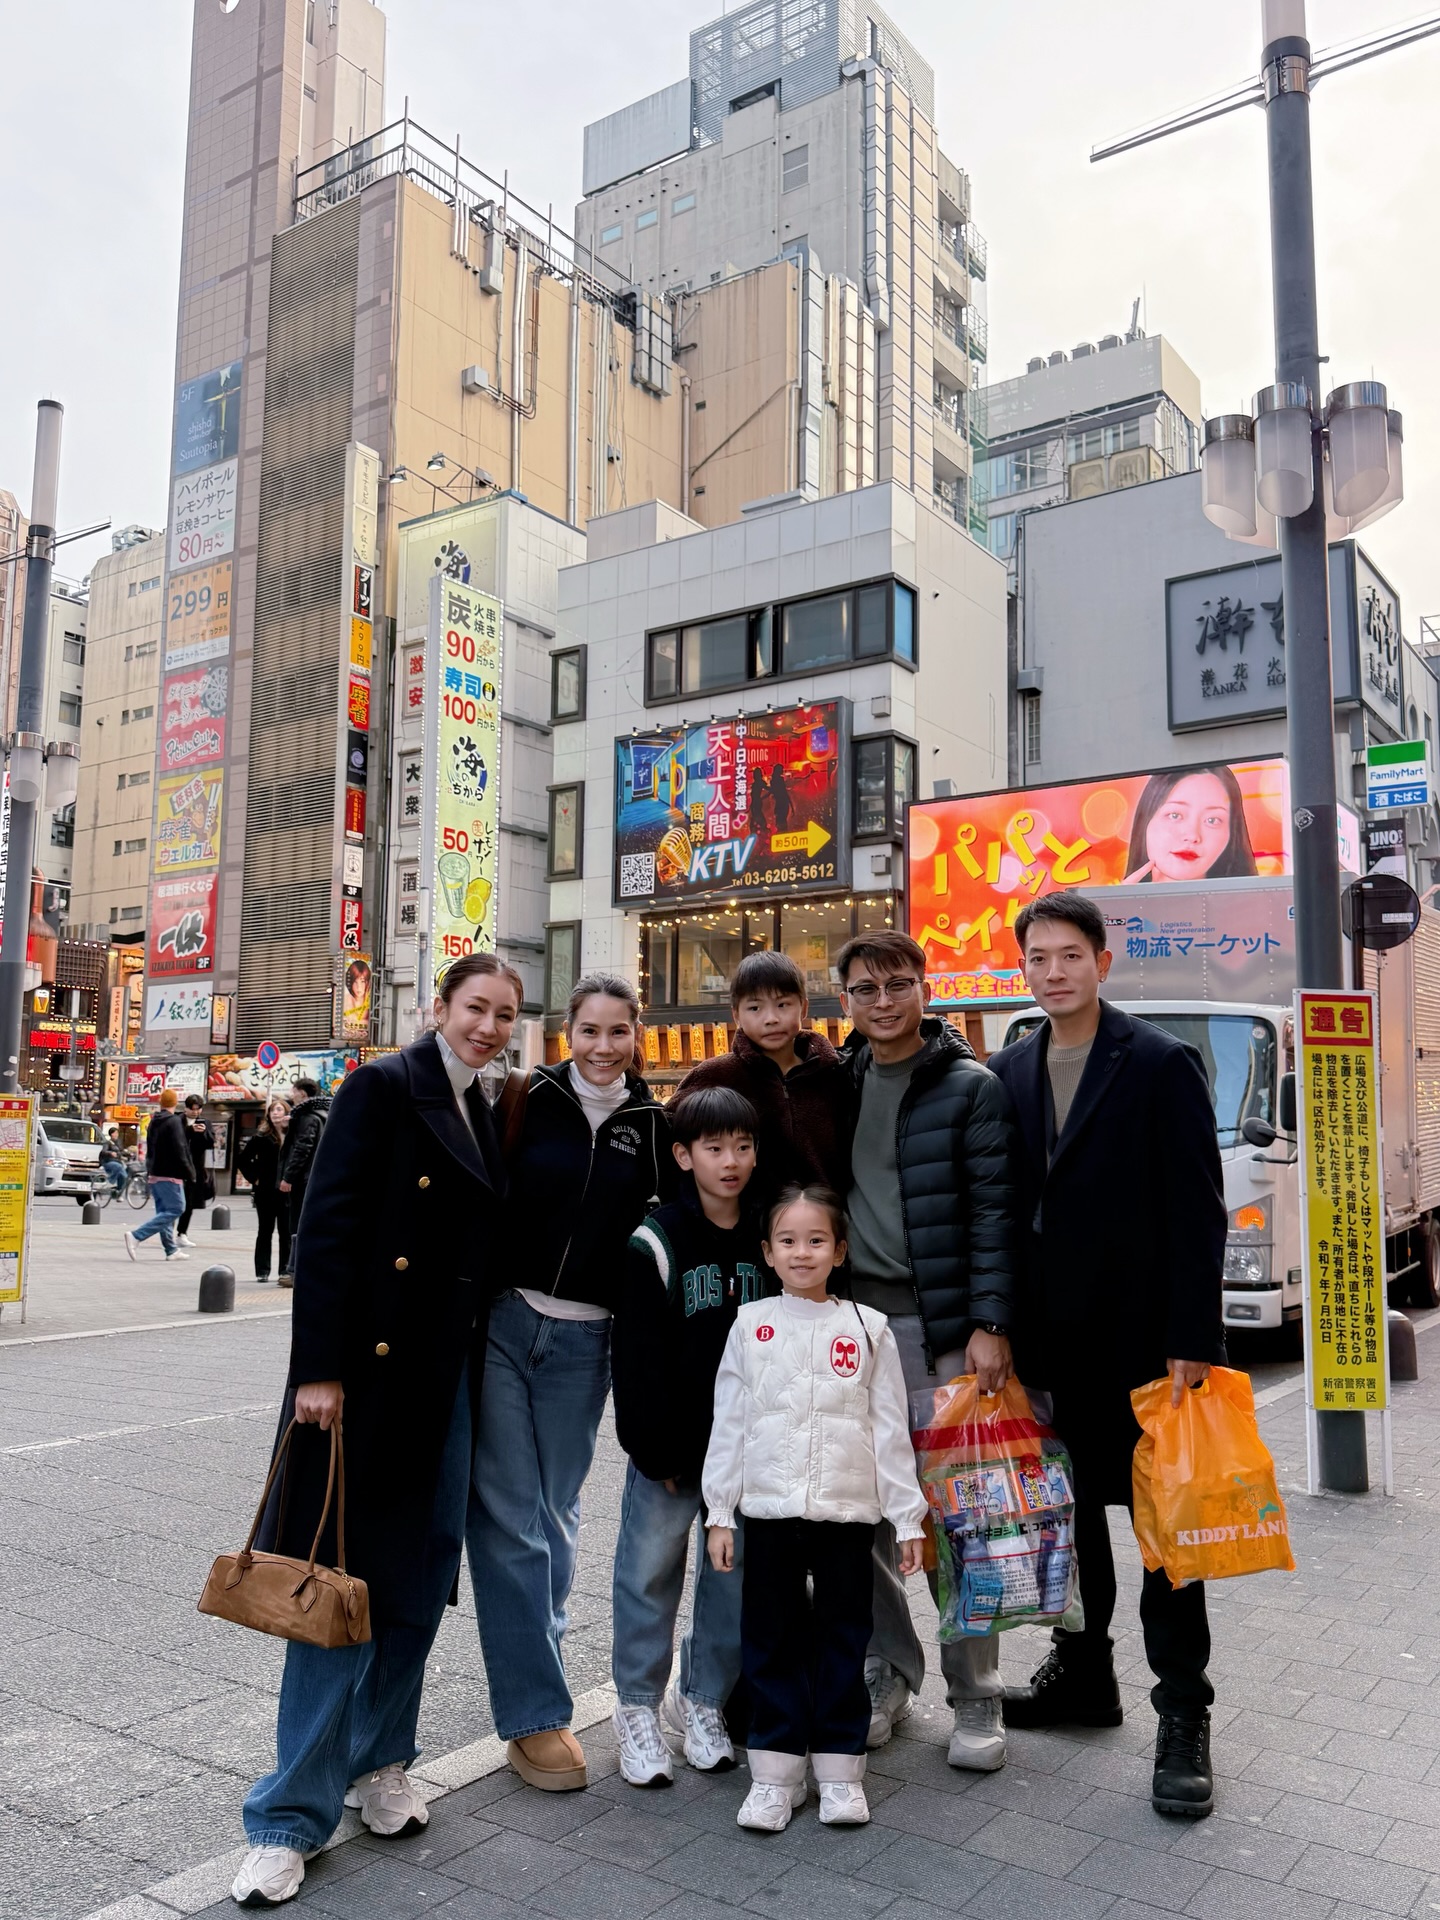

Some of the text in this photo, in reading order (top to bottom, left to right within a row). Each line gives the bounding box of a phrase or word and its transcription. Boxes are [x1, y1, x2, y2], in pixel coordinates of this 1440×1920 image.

[181, 386, 195, 402] 5F
[188, 418, 212, 434] shisha
[179, 439, 218, 462] Suutopia
[177, 467, 235, 499] ハイボール
[177, 489, 234, 517] レモンサワー
[175, 508, 233, 536] 豆挽きコーヒー
[360, 570, 371, 607] ダーツ
[446, 630, 495, 670] 90 円から
[444, 666, 482, 700] 寿司
[1202, 681, 1248, 698] KANKA
[350, 685, 369, 725] 麻雀
[443, 694, 496, 731] 100 円から
[166, 711, 209, 730] ダーツバー
[708, 725, 732, 841] 天上人間
[1370, 766, 1425, 781] FamilyMart
[175, 778, 204, 809] 低料金
[405, 763, 421, 816] 大衆
[452, 782, 484, 801] ちから
[1374, 791, 1423, 806] 酒 たばこ
[158, 818, 192, 841] 麻雀
[443, 827, 469, 853] 50
[484, 821, 494, 858] レモン
[472, 838, 485, 876] サワー
[689, 836, 754, 881] KTV
[934, 811, 1092, 895] パパッと
[745, 863, 834, 885] 03-6205-5612
[347, 886, 358, 896] 3F
[401, 872, 418, 925] 酒場
[159, 910, 207, 957] 一休
[1160, 925, 1216, 935] New generation
[442, 934, 473, 957] 150
[1127, 932, 1281, 959] 物流マーケット
[197, 957, 211, 969] 2F
[928, 973, 1034, 999] 心安全に出
[1310, 1006, 1364, 1034] 通告
[143, 1076, 163, 1095] 一休
[611, 1125, 641, 1144] HOLLYWOOD
[1311, 1053, 1327, 1196] 場合には、区が処分します。
[610, 1138, 618, 1148] LOS
[618, 1142, 636, 1155] ANGELES
[1318, 1240, 1333, 1344] 令和7年7月25日
[760, 1327, 769, 1340] B
[1322, 1377, 1376, 1389] 新宿警察署
[1177, 1519, 1286, 1547] KIDDY LAN
